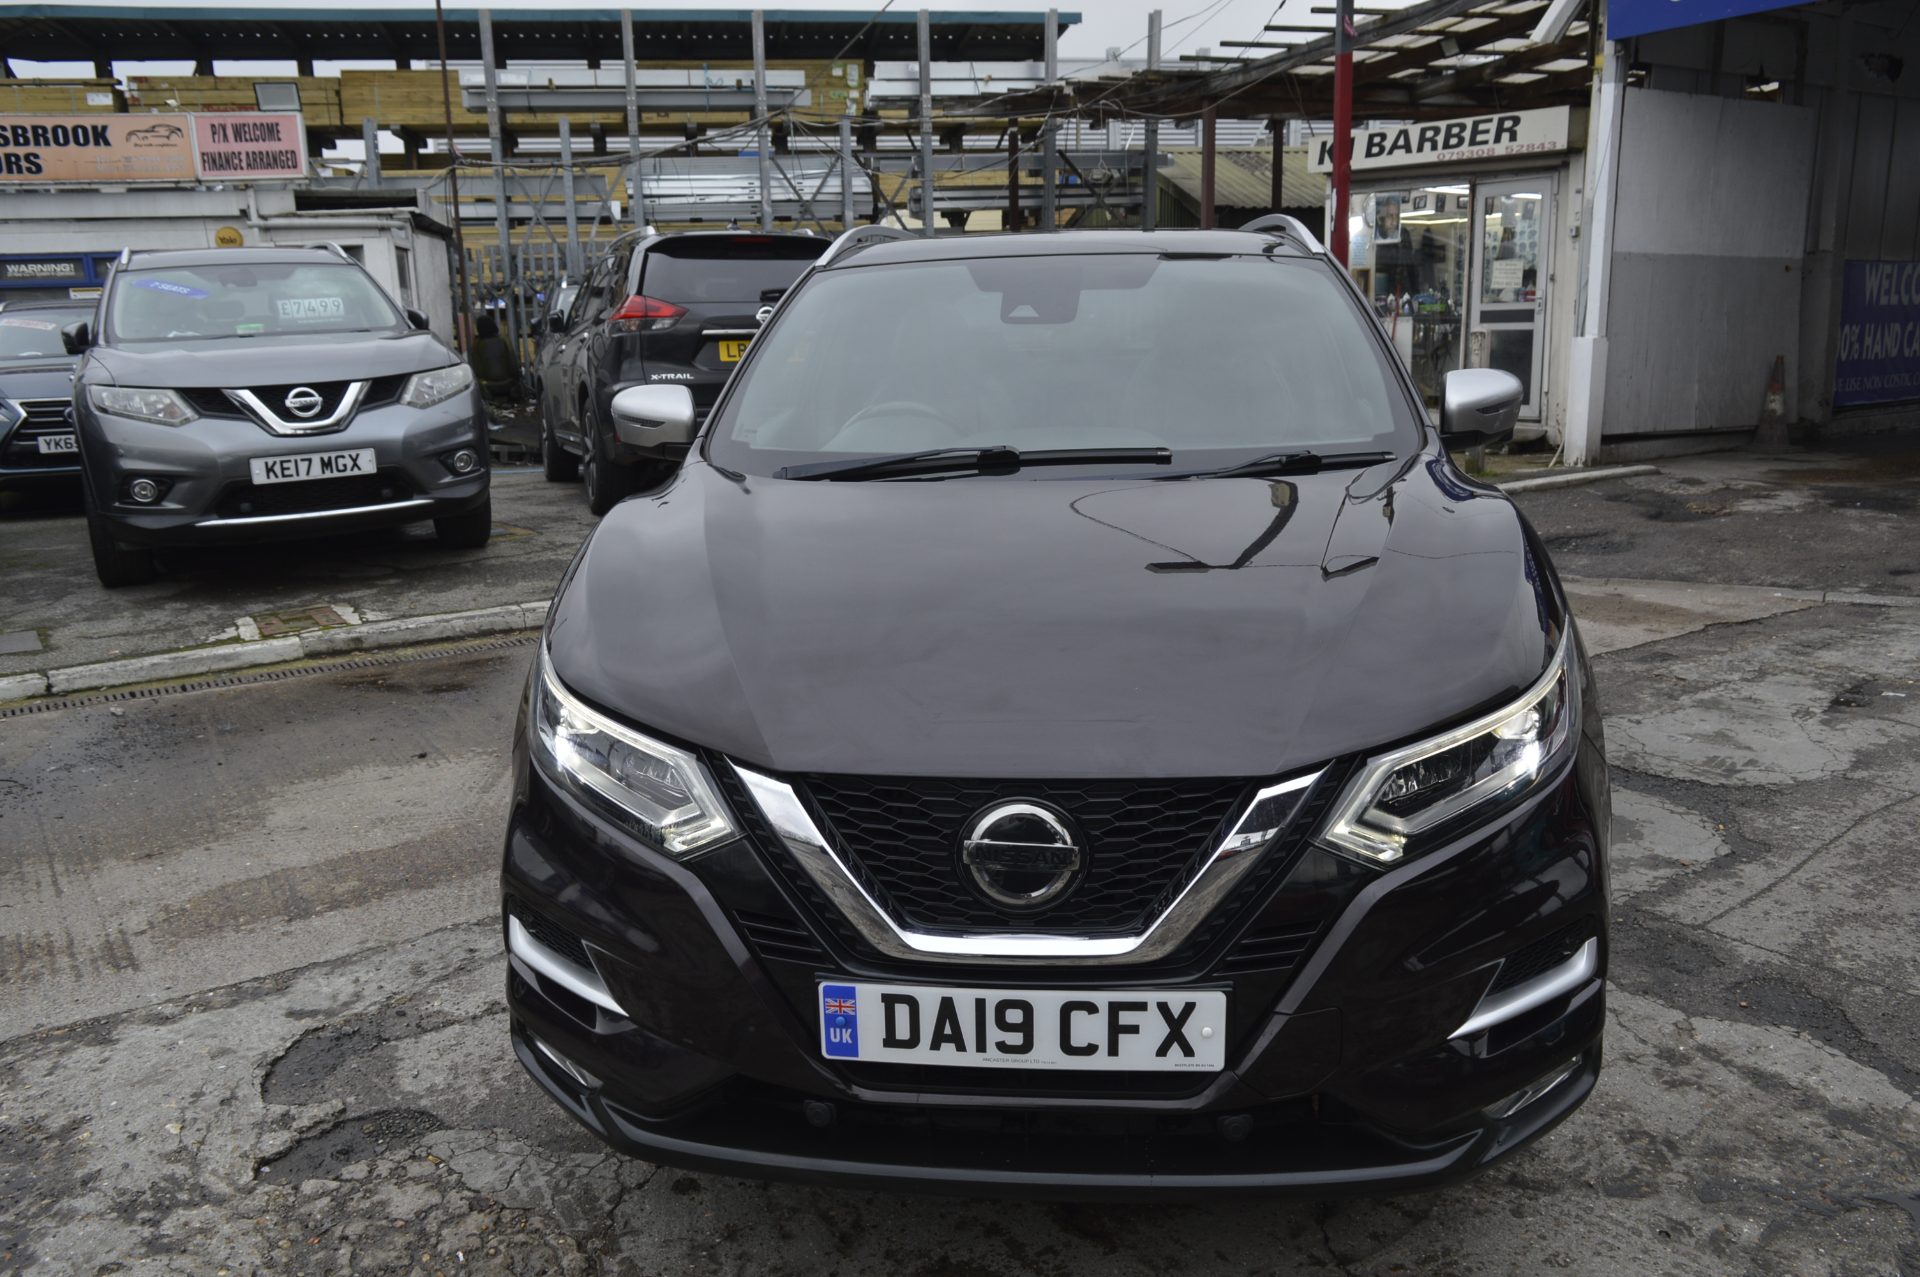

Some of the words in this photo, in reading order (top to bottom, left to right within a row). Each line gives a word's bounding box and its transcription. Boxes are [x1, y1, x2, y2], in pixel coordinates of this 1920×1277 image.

[210, 122, 229, 143] P/X
[231, 122, 282, 143] WELCOME
[1317, 136, 1356, 166] K
[1364, 115, 1521, 159] BARBER
[0, 153, 43, 174] RS
[201, 151, 244, 172] FINANCE
[245, 150, 298, 171] ARRANGED
[6, 263, 75, 273] WARNING!
[280, 298, 342, 317] £7499
[1863, 321, 1902, 361] HAND
[650, 373, 694, 381] X-TRAIL
[264, 457, 313, 480] KE17
[320, 453, 362, 475] MGX
[975, 846, 1072, 864] NISSAN
[880, 992, 1035, 1056] DA19
[1059, 1000, 1197, 1058] CFX
[830, 1027, 853, 1045] UK
